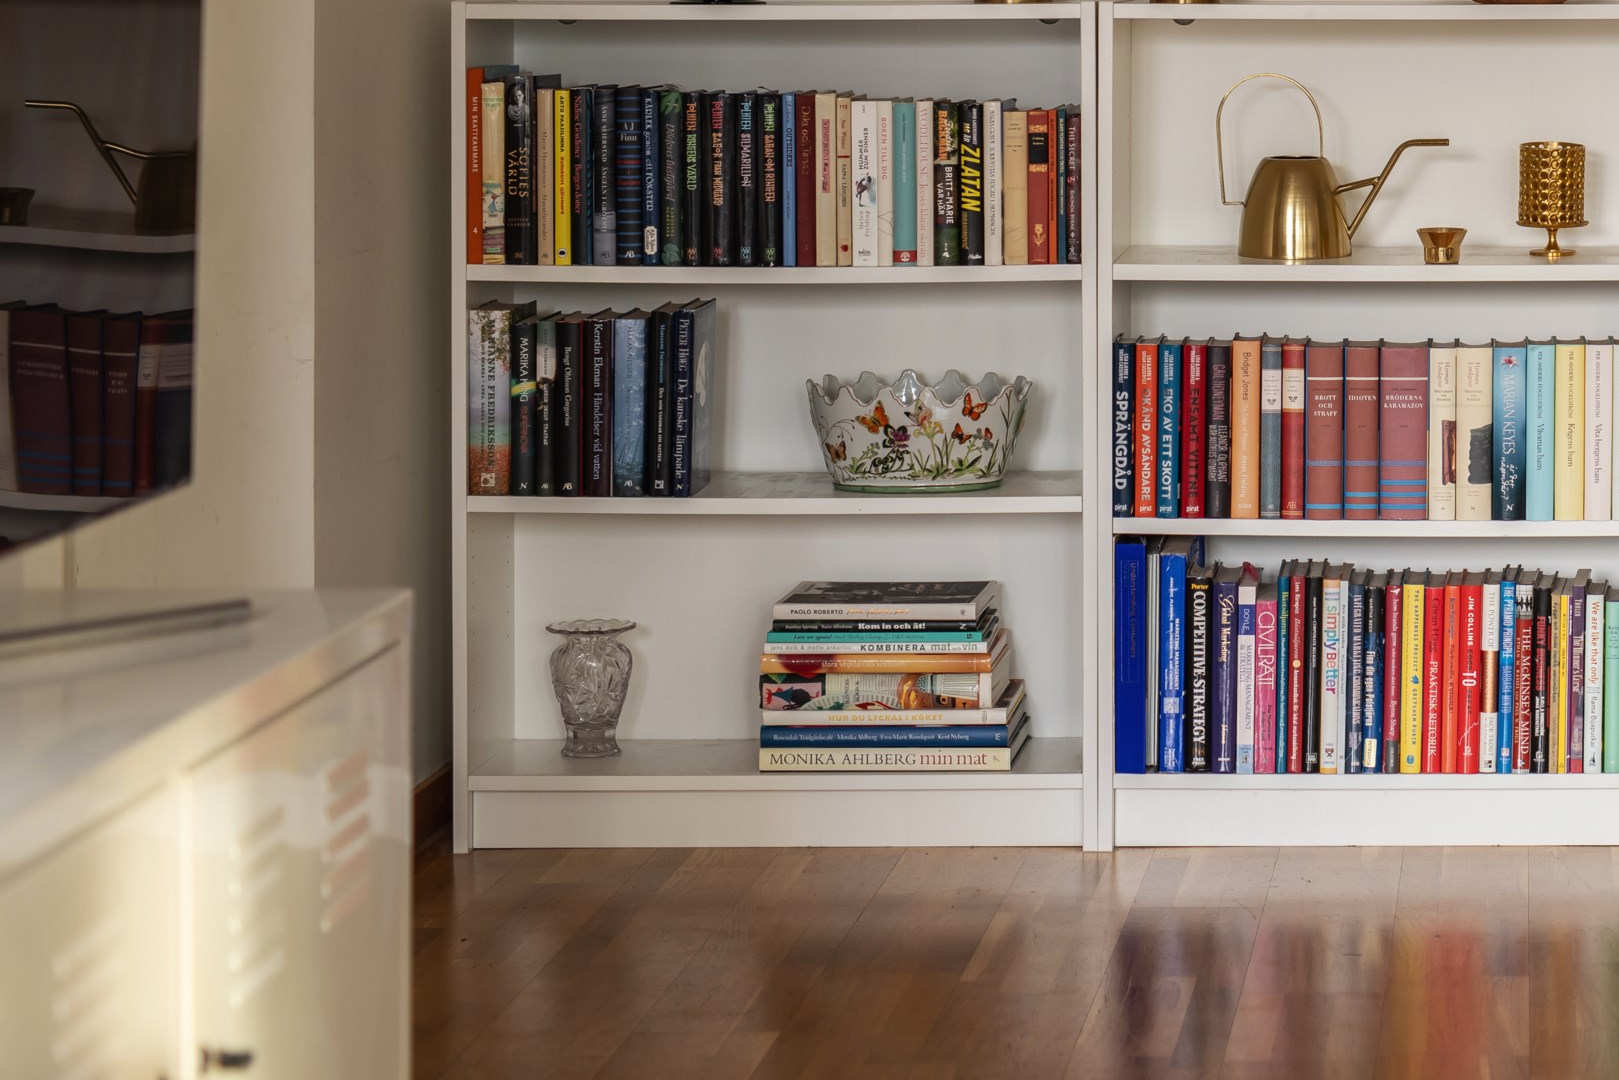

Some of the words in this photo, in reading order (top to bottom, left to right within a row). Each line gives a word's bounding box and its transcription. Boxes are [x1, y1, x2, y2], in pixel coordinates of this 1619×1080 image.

[938, 110, 947, 161] BACKMAN
[963, 133, 971, 143] ÄR
[518, 147, 528, 198] SOFIES
[573, 164, 581, 191] Burgers
[960, 144, 981, 212] ZLATAN
[937, 199, 946, 215] HÄR
[593, 323, 603, 354] Kerstin
[679, 319, 690, 345] PETER
[519, 338, 528, 377] MARIKA
[678, 348, 690, 372] HØEG
[1241, 352, 1251, 378] Bridget
[593, 357, 603, 388] Ekman
[677, 379, 688, 393] De
[519, 378, 528, 402] KING
[1163, 388, 1173, 413] EKO
[1241, 379, 1251, 401] Jones
[1503, 374, 1516, 418] MARIAN
[593, 392, 603, 436] Händelser
[676, 396, 687, 431] kanske
[1141, 388, 1154, 431] OKÄND
[1163, 416, 1173, 432] AV
[593, 438, 602, 452] vid
[1114, 391, 1132, 490] SPRÄNGDÅD
[1162, 434, 1173, 455] ETT
[1503, 421, 1516, 455] KEYES
[593, 454, 602, 480] vatten
[675, 435, 686, 479] lämpade
[1140, 433, 1153, 501] AVSÄNDARE
[1161, 459, 1172, 500] SKOTT
[1591, 601, 1600, 615] We
[911, 622, 926, 630] ät!
[1193, 591, 1206, 675] COMPETITIVE
[1522, 626, 1531, 651] THE
[1590, 632, 1600, 646] like
[860, 644, 926, 652] KOMBINERA
[930, 643, 951, 651] mat
[1257, 611, 1275, 690] CIVILRÄTT
[1590, 646, 1599, 665] that
[1428, 661, 1438, 711] PRAKTISK
[1521, 655, 1530, 719] McKINSEY
[1588, 667, 1599, 684] only
[1192, 676, 1206, 744] STRATEGY
[1428, 713, 1437, 756] RETORIK
[1520, 721, 1529, 755] MIND
[770, 753, 835, 765] MONIKA
[841, 753, 916, 765] AHLBERG
[919, 750, 952, 765] min
[956, 753, 987, 765] mat
